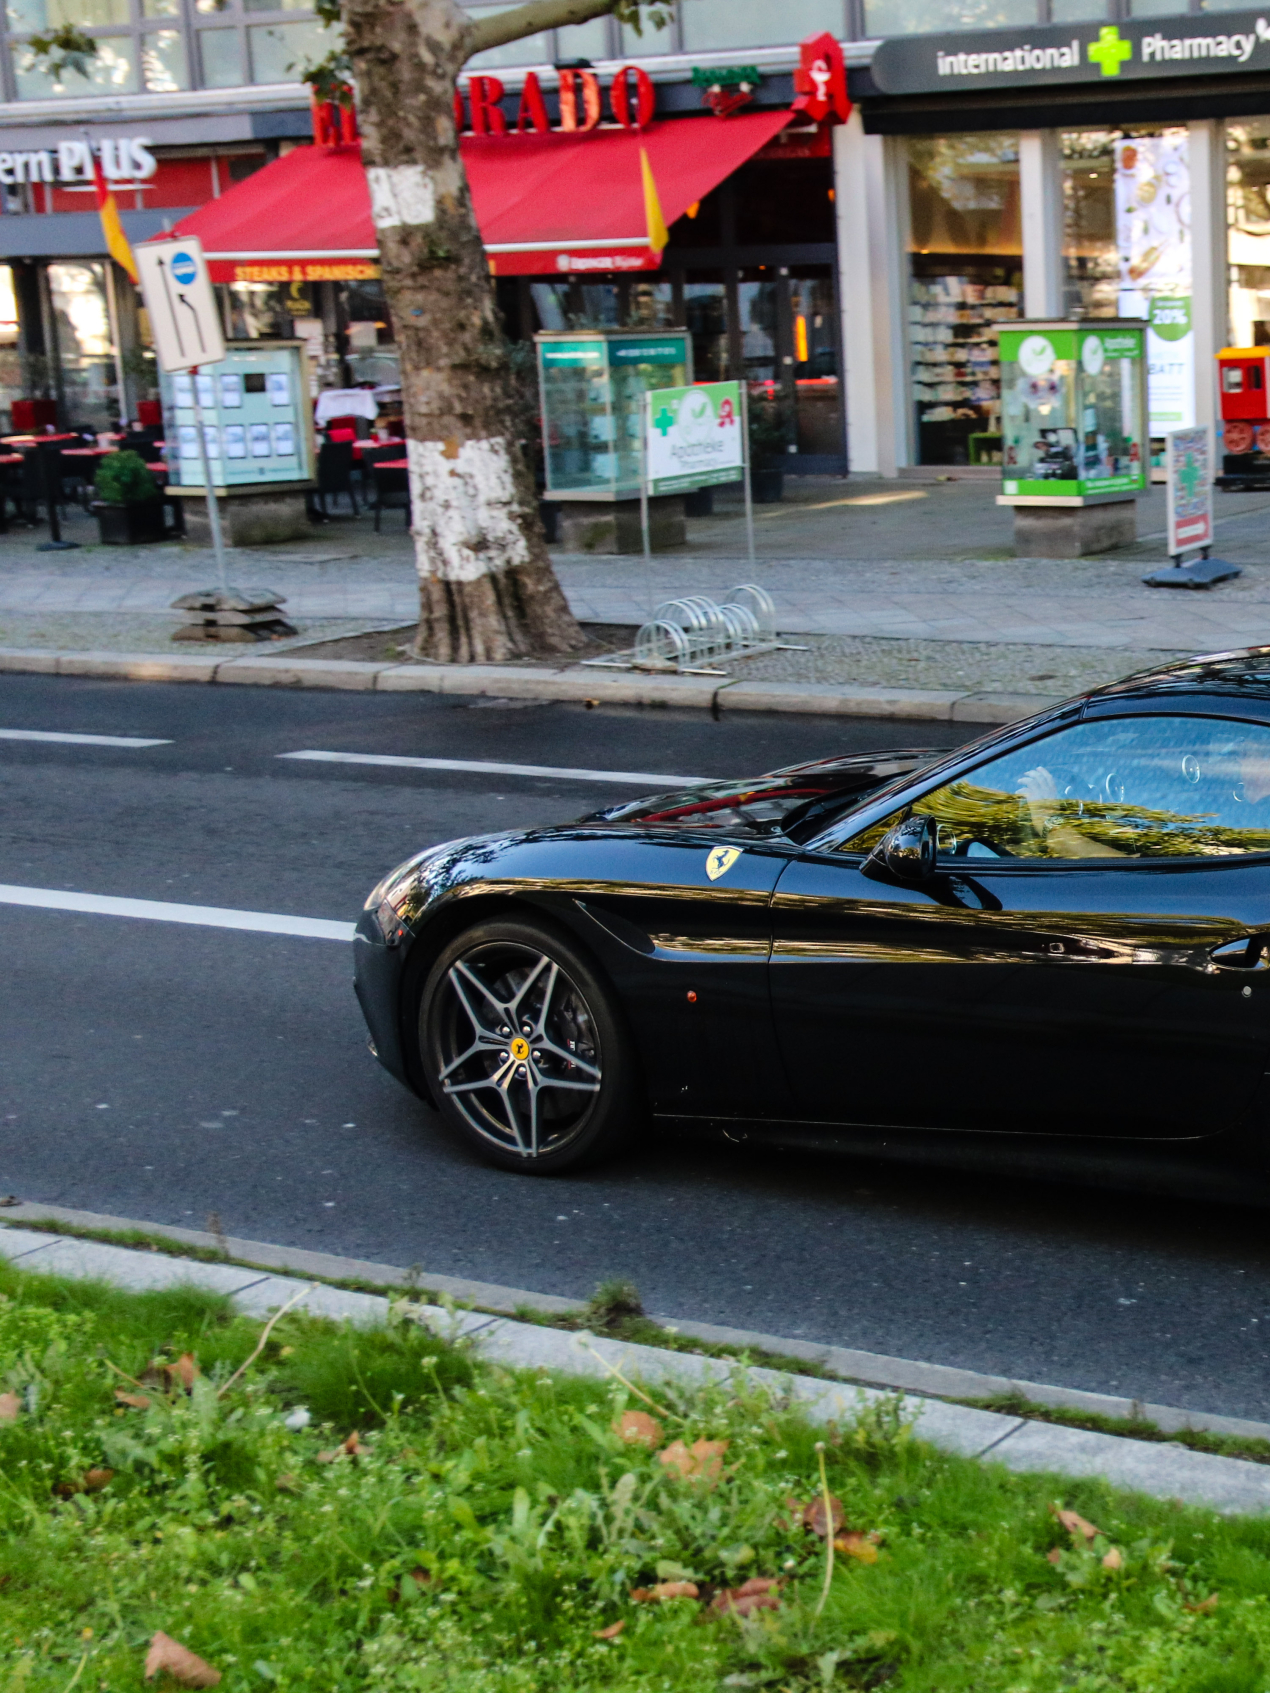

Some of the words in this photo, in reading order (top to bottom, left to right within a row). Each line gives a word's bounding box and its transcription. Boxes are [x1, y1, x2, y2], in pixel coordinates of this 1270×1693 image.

[937, 39, 1080, 76] international
[1141, 32, 1256, 63] Pharmacy
[235, 265, 289, 281] STEAKS
[1152, 308, 1188, 325] 20%
